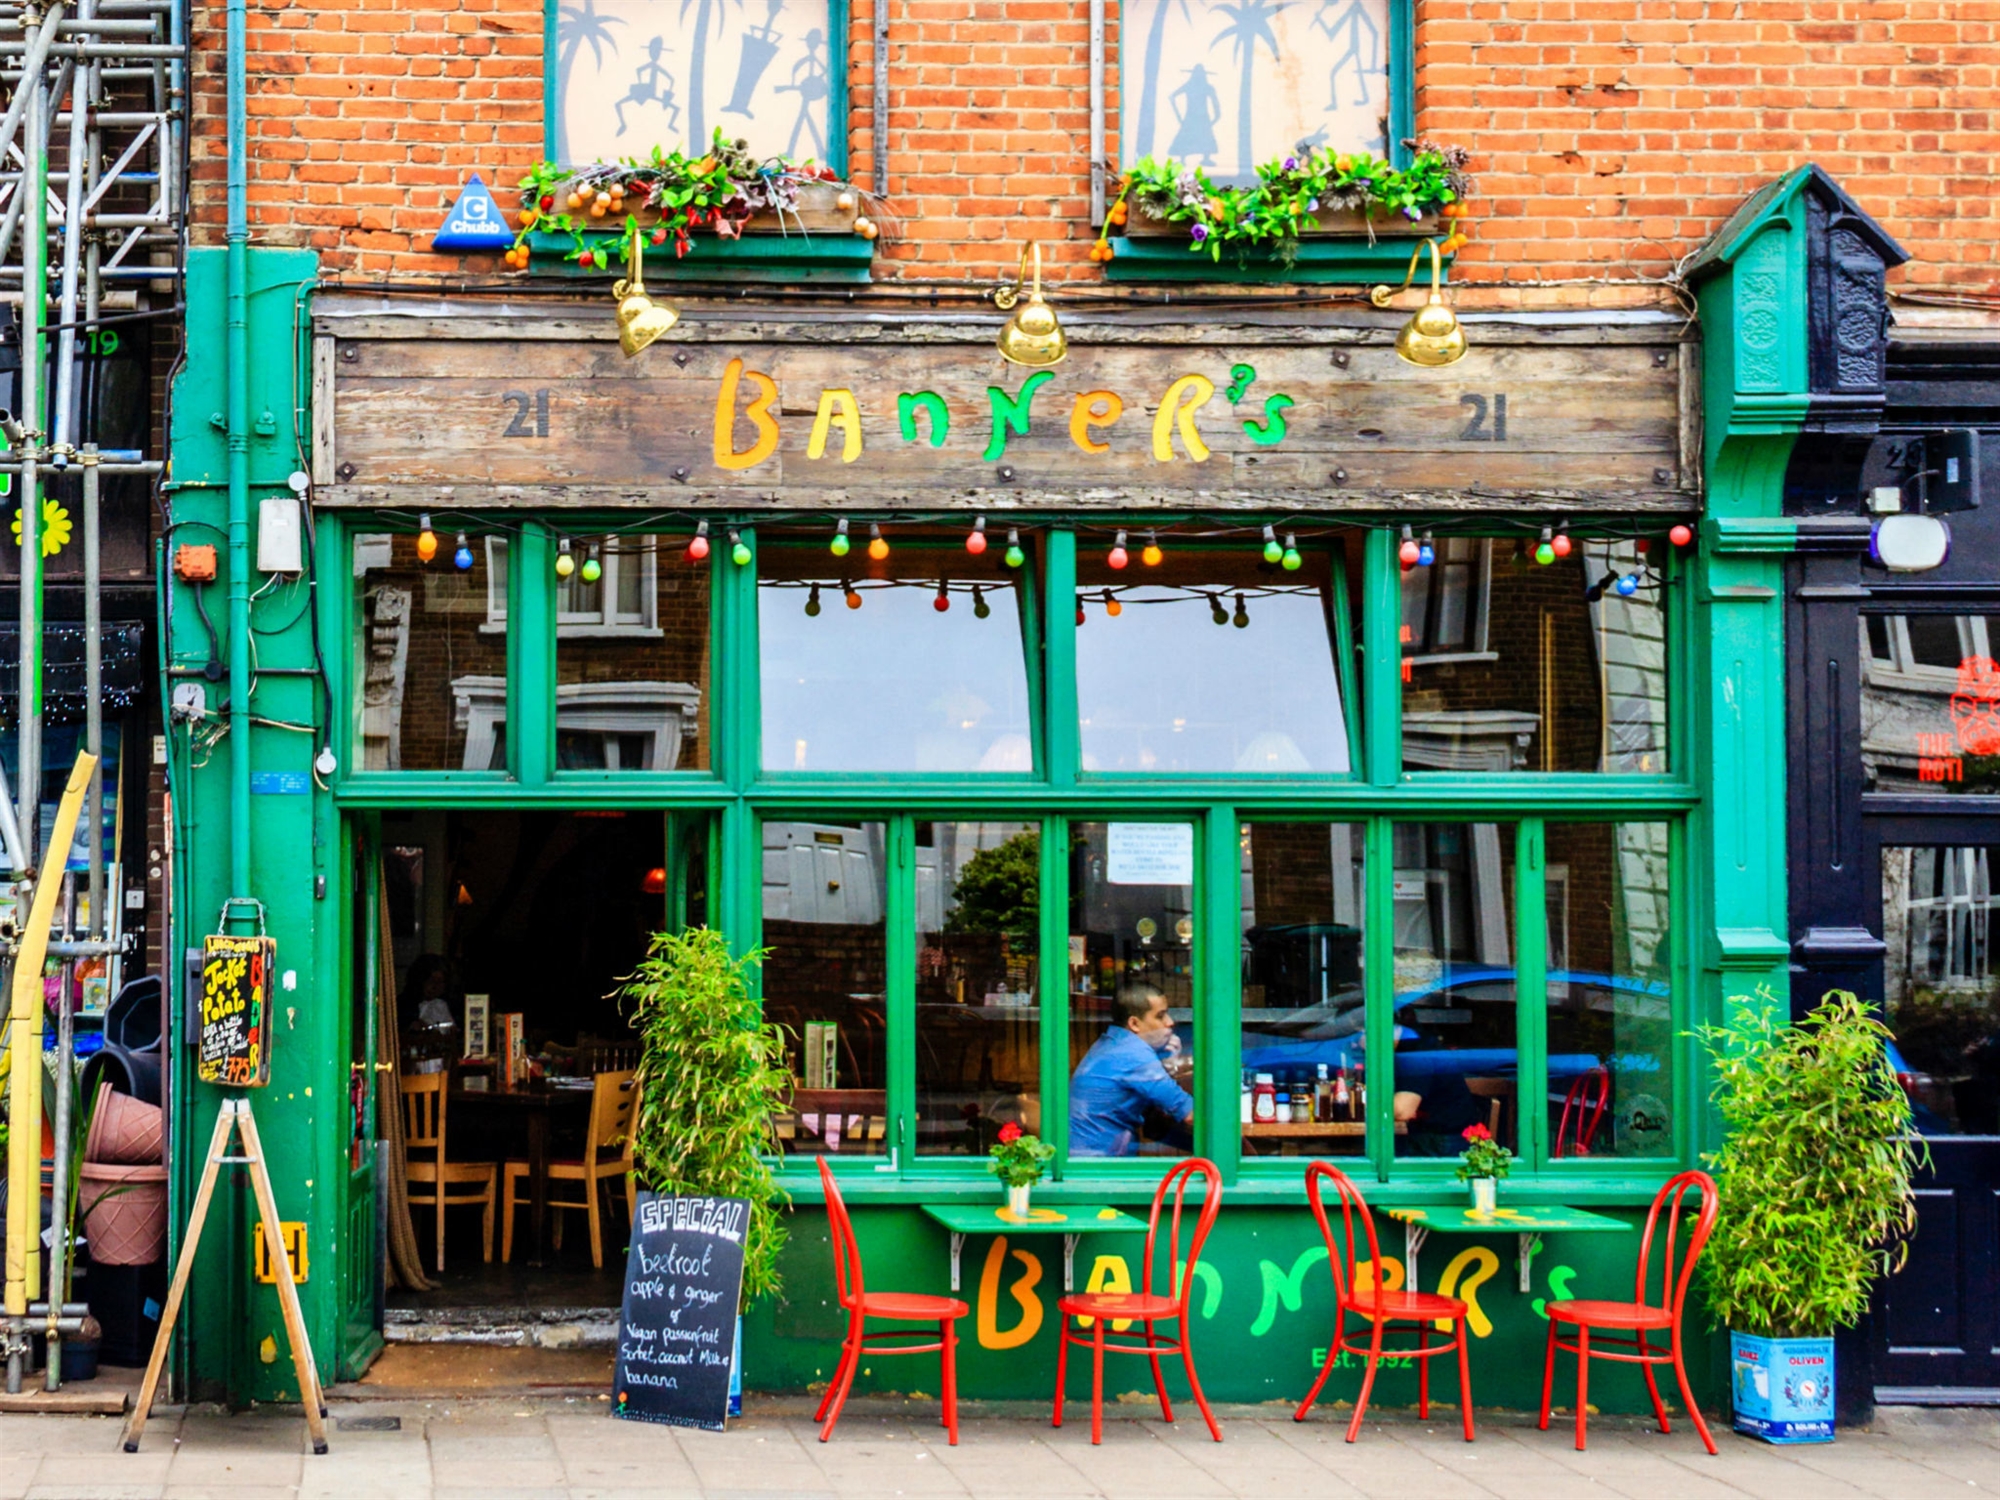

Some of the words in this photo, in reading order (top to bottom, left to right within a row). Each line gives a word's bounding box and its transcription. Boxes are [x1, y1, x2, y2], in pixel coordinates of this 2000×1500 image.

[451, 220, 500, 234] Chubb
[87, 330, 119, 356] 19
[502, 388, 549, 438] 21
[1460, 393, 1507, 442] 21
[1916, 733, 1954, 756] THE
[1918, 758, 1963, 781] ROTI
[203, 987, 246, 1027] Potato
[263, 1229, 300, 1276] H
[637, 1242, 714, 1277] beetroot
[630, 1275, 665, 1300] apple
[681, 1286, 724, 1309] ginger
[669, 1308, 682, 1324] or
[1789, 1357, 1825, 1366] OLIVEN
[624, 1365, 678, 1389] banana
